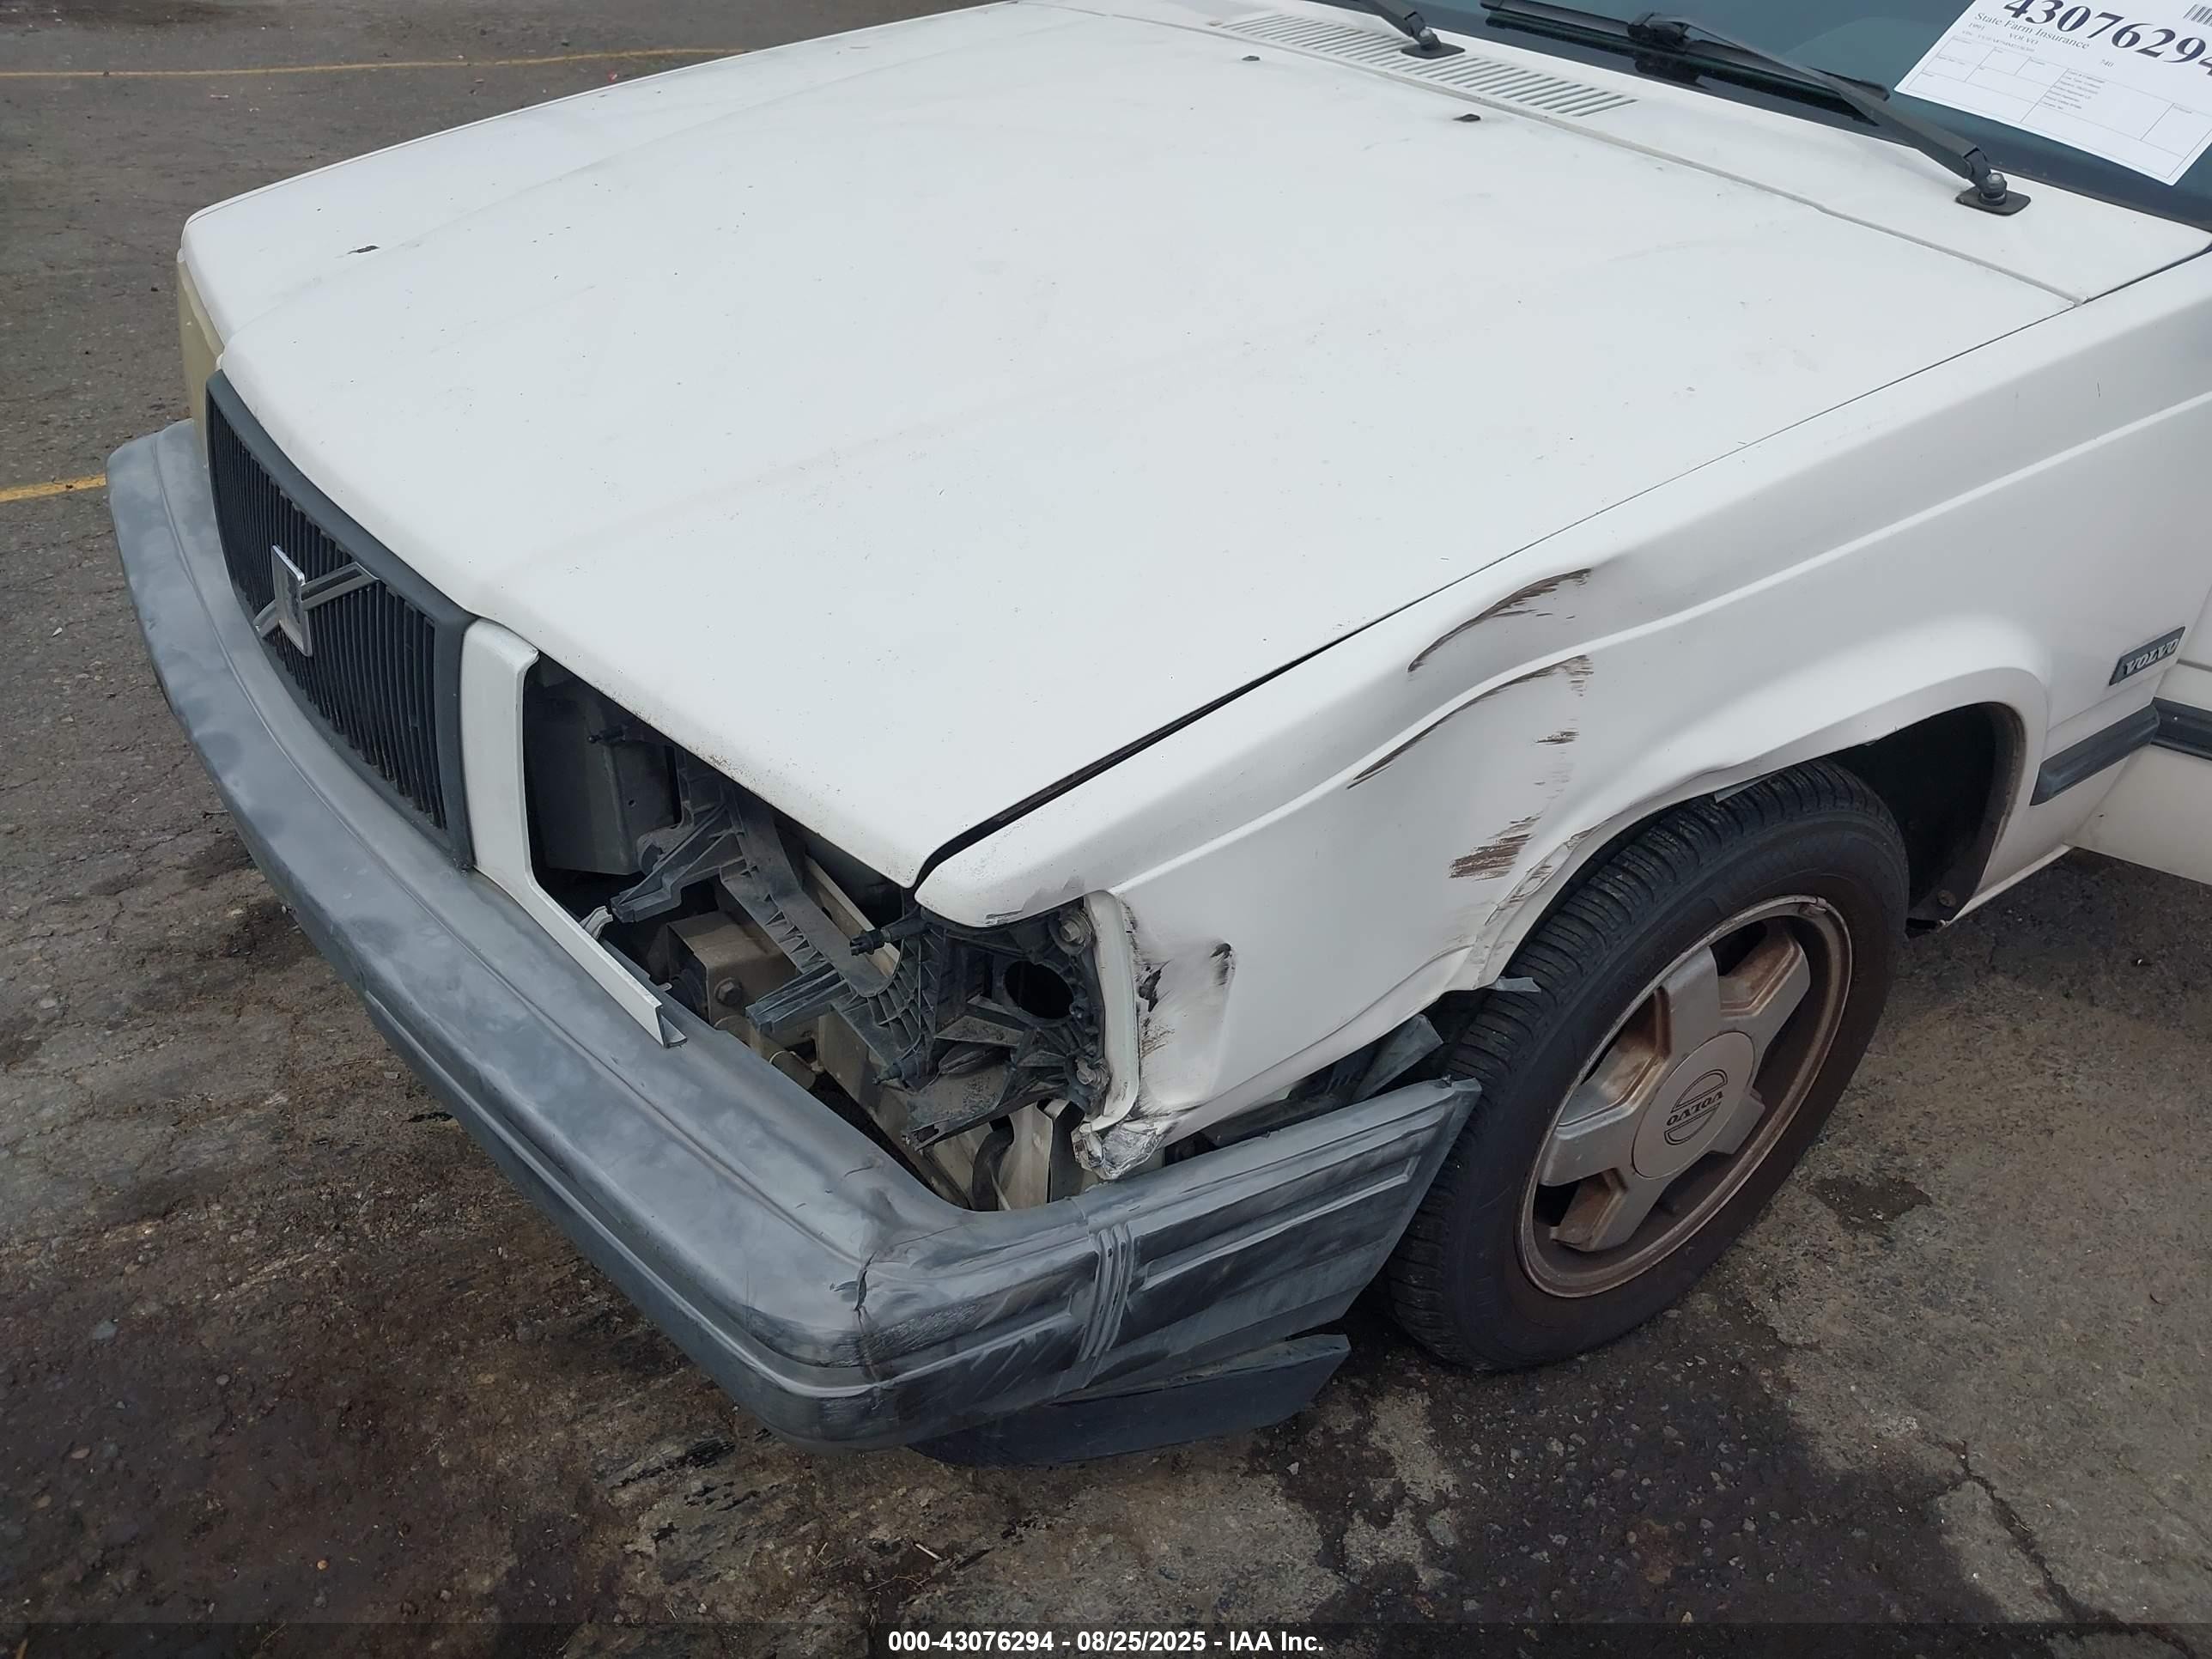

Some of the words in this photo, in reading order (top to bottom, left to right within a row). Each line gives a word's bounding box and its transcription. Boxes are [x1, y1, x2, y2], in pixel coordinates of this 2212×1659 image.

[1977, 13, 2002, 26] State
[2004, 20, 2033, 34] Farm
[2035, 28, 2089, 50] Insurance
[2125, 638, 2179, 675] VOLVO
[1666, 1091, 1723, 1127] VOLVO
